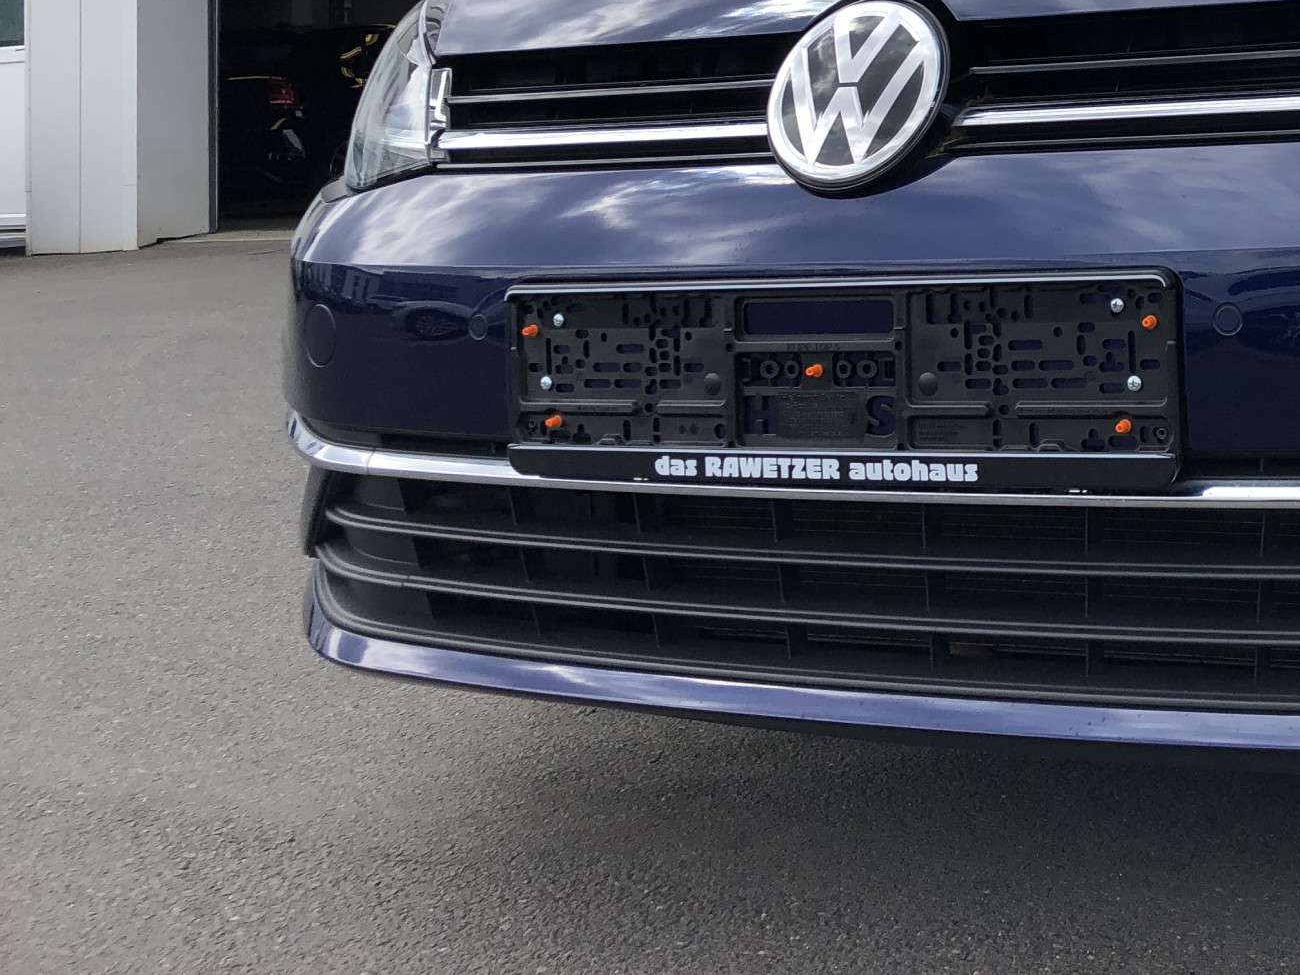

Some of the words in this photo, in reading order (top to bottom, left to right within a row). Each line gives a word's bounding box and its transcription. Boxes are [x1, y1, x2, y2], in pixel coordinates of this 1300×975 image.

[784, 5, 932, 171] VW
[654, 455, 698, 477] das
[704, 456, 841, 480] RAWETZER
[848, 459, 979, 482] autohaus
